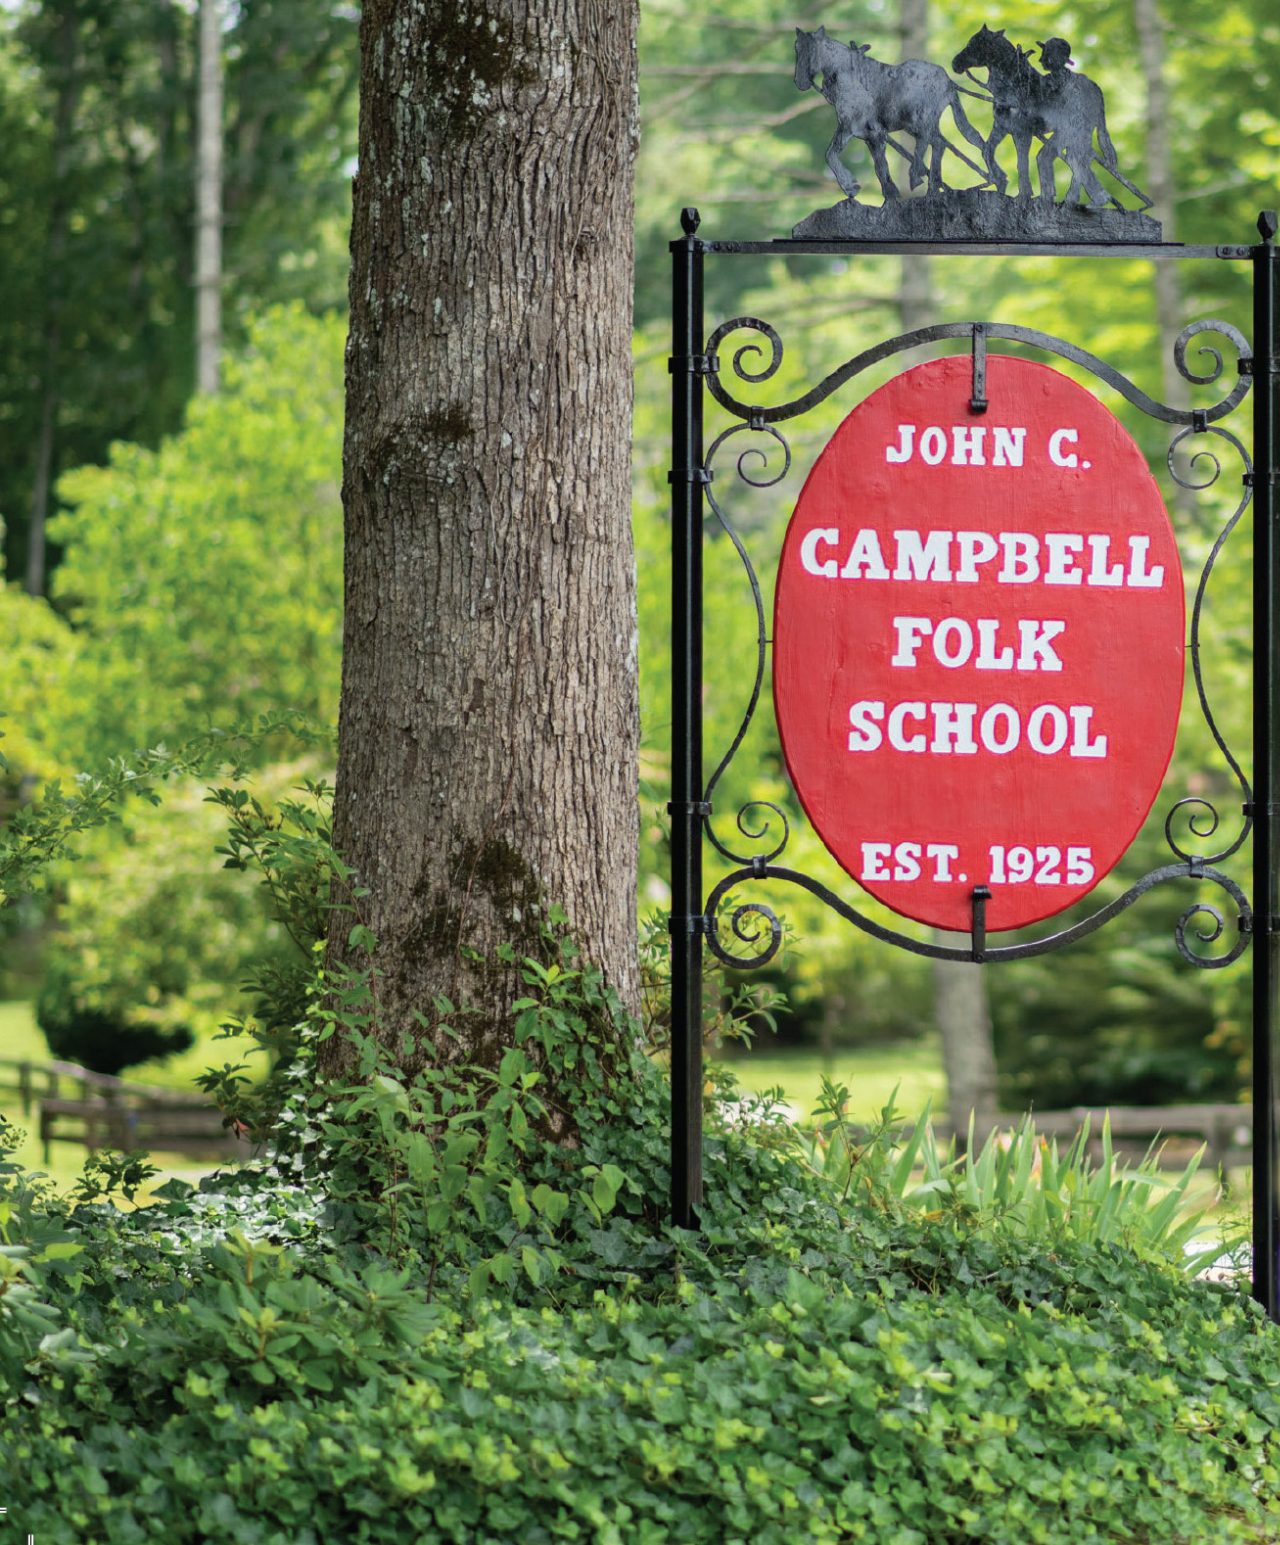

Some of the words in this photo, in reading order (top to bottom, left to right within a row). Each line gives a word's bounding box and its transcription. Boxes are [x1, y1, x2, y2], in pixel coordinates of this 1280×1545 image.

[886, 424, 1027, 467] JOHN
[1048, 428, 1092, 469] C.
[800, 527, 1165, 588] CAMPBELL
[891, 616, 1066, 672] FOLK
[848, 700, 1107, 758] SCHOOL
[861, 842, 967, 883] EST.
[989, 845, 1095, 885] 1925
